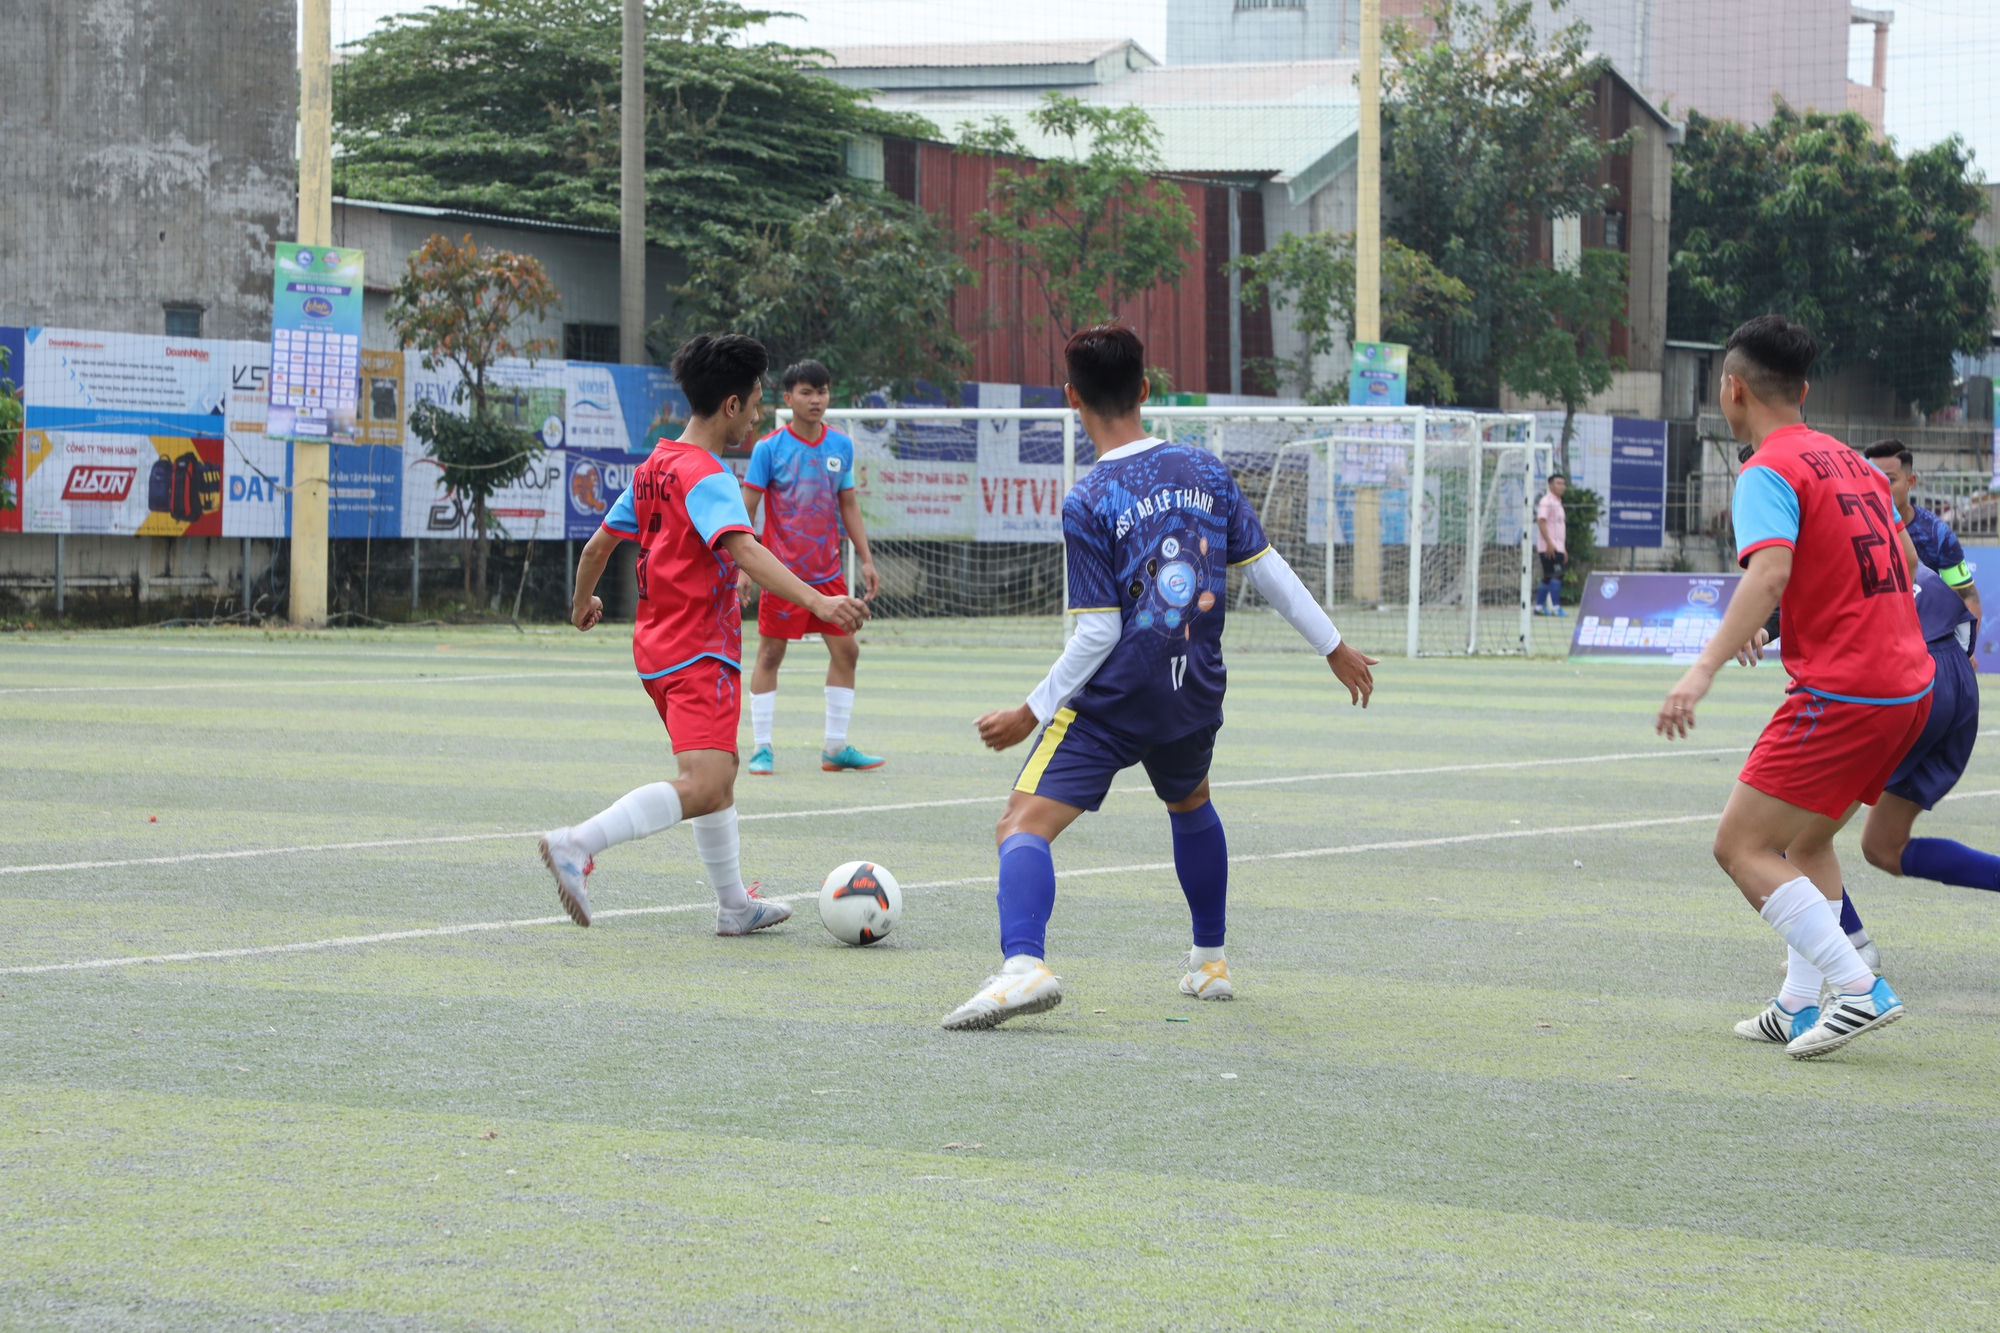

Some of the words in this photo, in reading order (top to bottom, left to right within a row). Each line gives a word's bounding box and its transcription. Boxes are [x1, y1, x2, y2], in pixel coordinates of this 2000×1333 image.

[1799, 450, 1843, 481] BHT
[1841, 449, 1871, 479] FC
[981, 476, 1065, 515] VITVI
[1136, 497, 1154, 520] AB
[1155, 488, 1172, 512] LÊ
